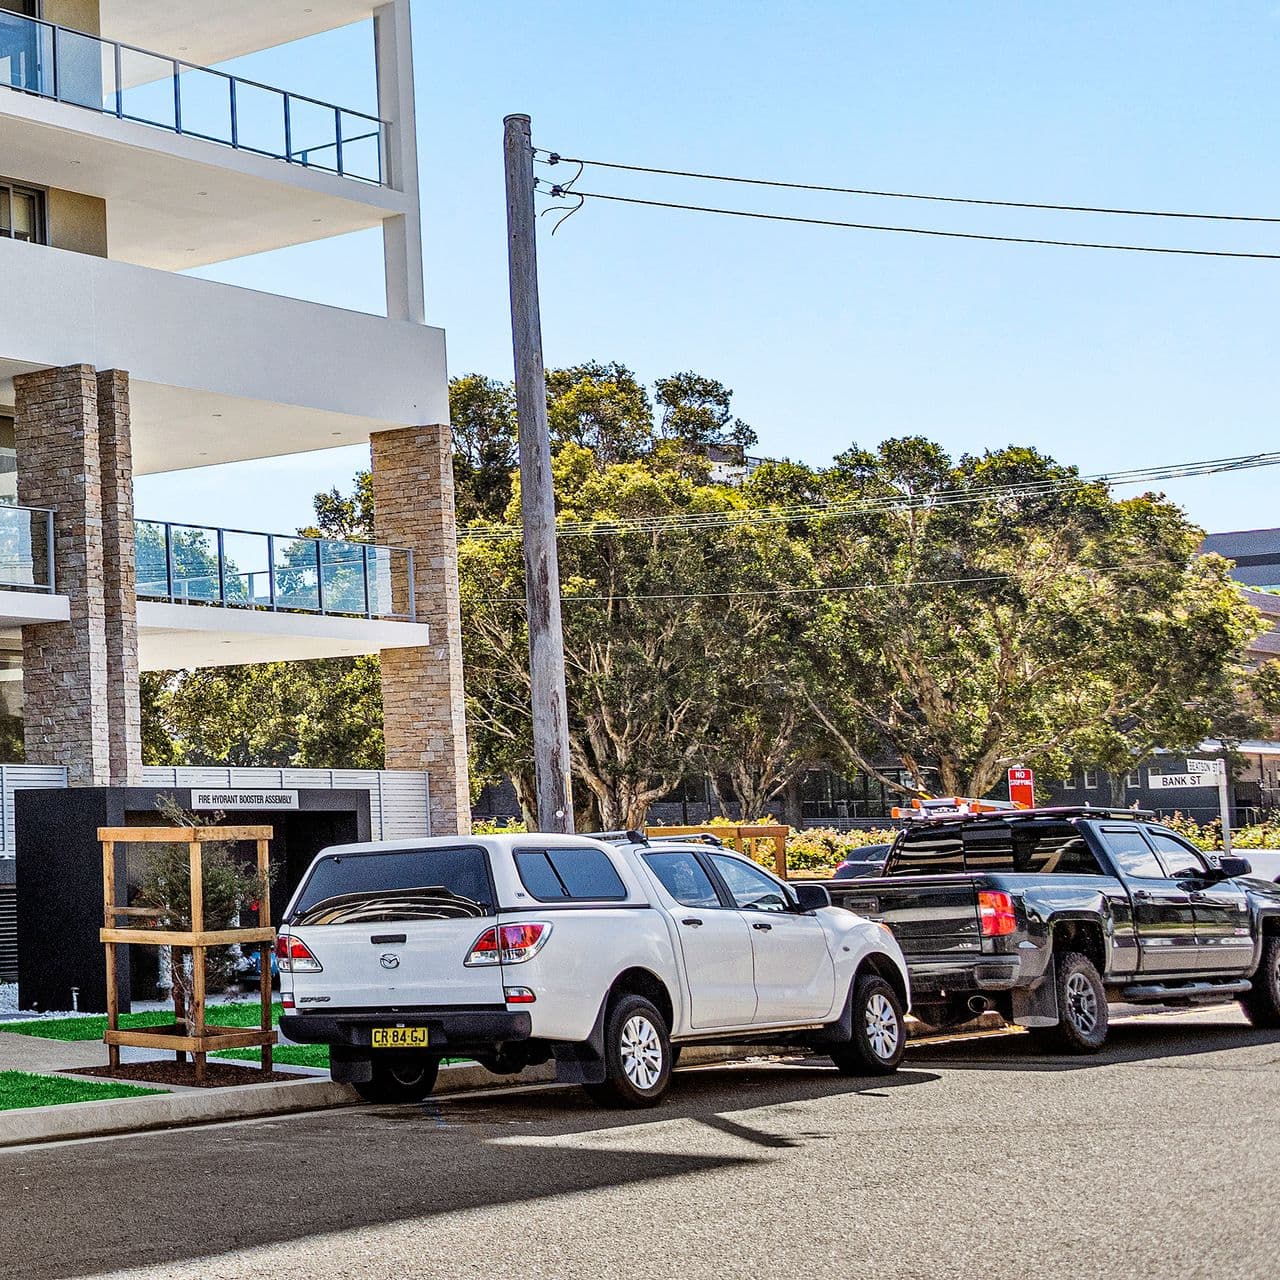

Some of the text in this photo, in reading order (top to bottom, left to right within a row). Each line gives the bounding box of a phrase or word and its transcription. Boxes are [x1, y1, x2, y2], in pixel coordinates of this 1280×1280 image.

[1015, 771, 1025, 779] NO
[1162, 775, 1201, 786] BANK ST
[198, 794, 292, 804] FIRE HYDRANT BOOSTER ASSEMBLY
